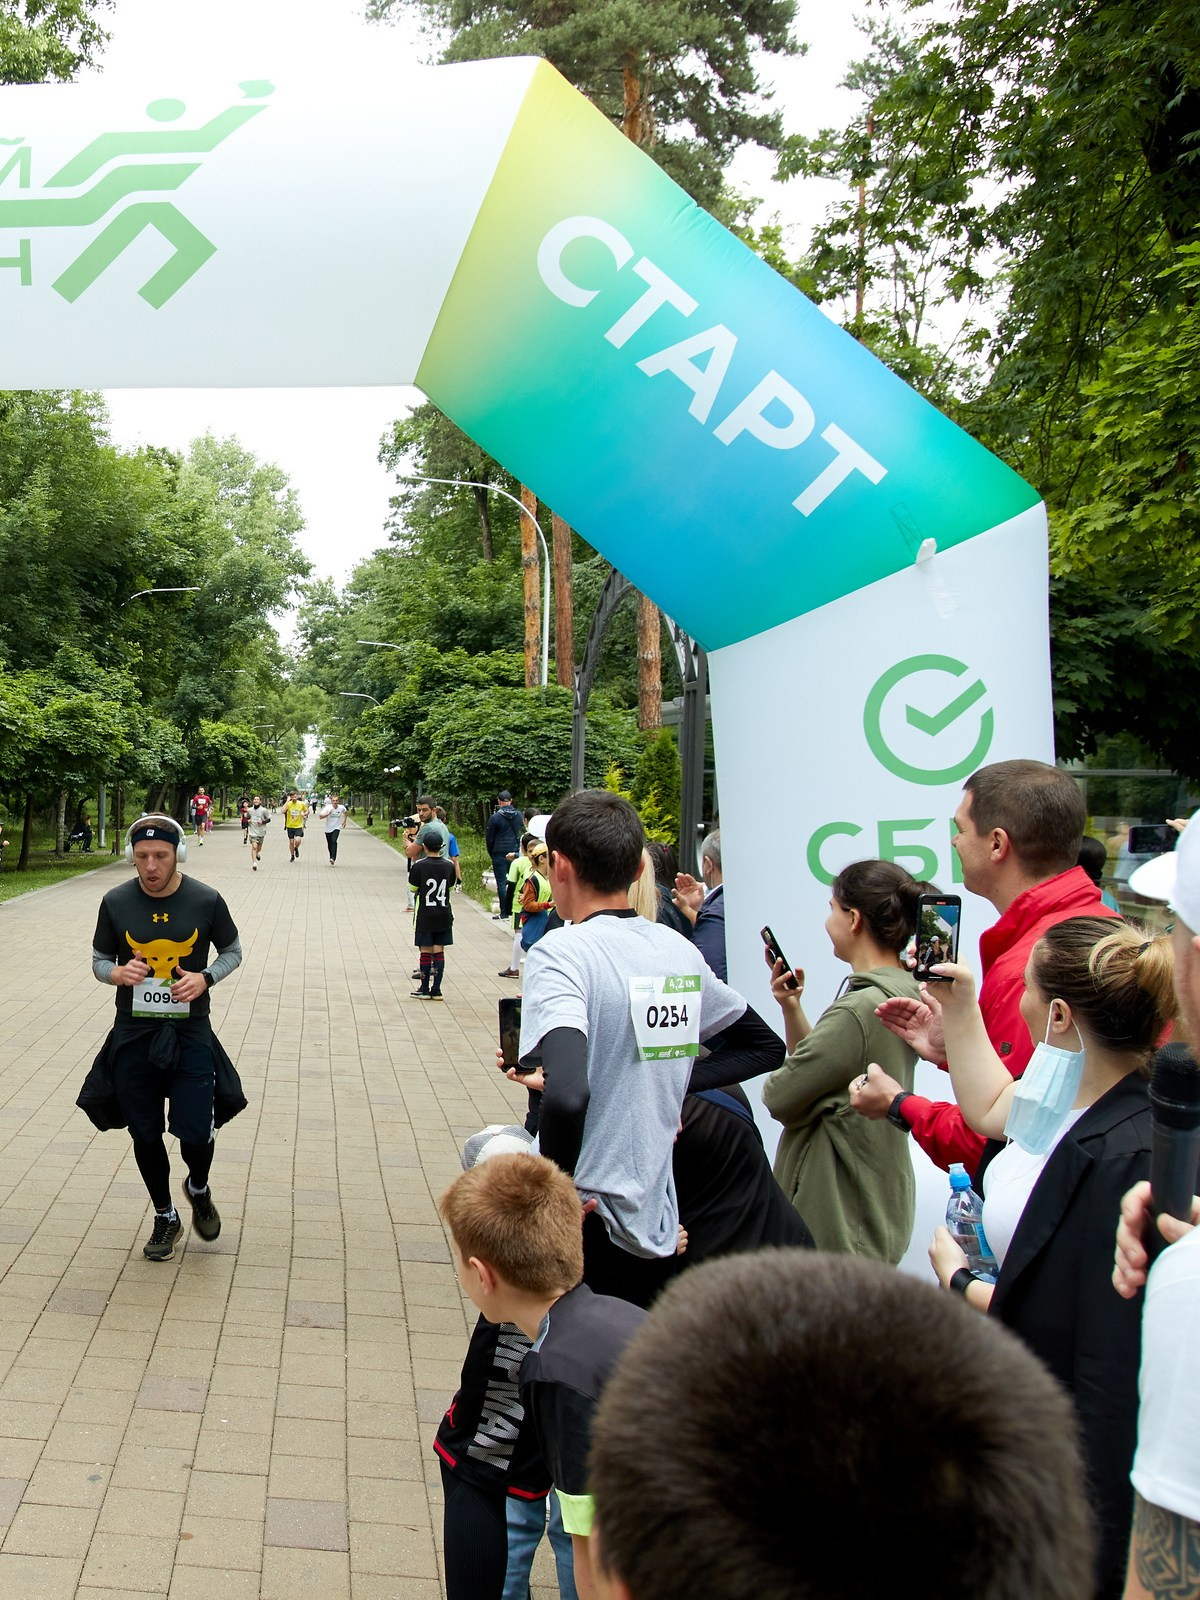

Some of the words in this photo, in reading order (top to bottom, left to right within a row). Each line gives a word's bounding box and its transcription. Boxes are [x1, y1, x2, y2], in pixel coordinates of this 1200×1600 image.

[537, 215, 889, 518] СТАРТ
[425, 878, 447, 907] 24
[646, 1004, 689, 1029] 0254
[466, 1322, 535, 1471] MPMAN
